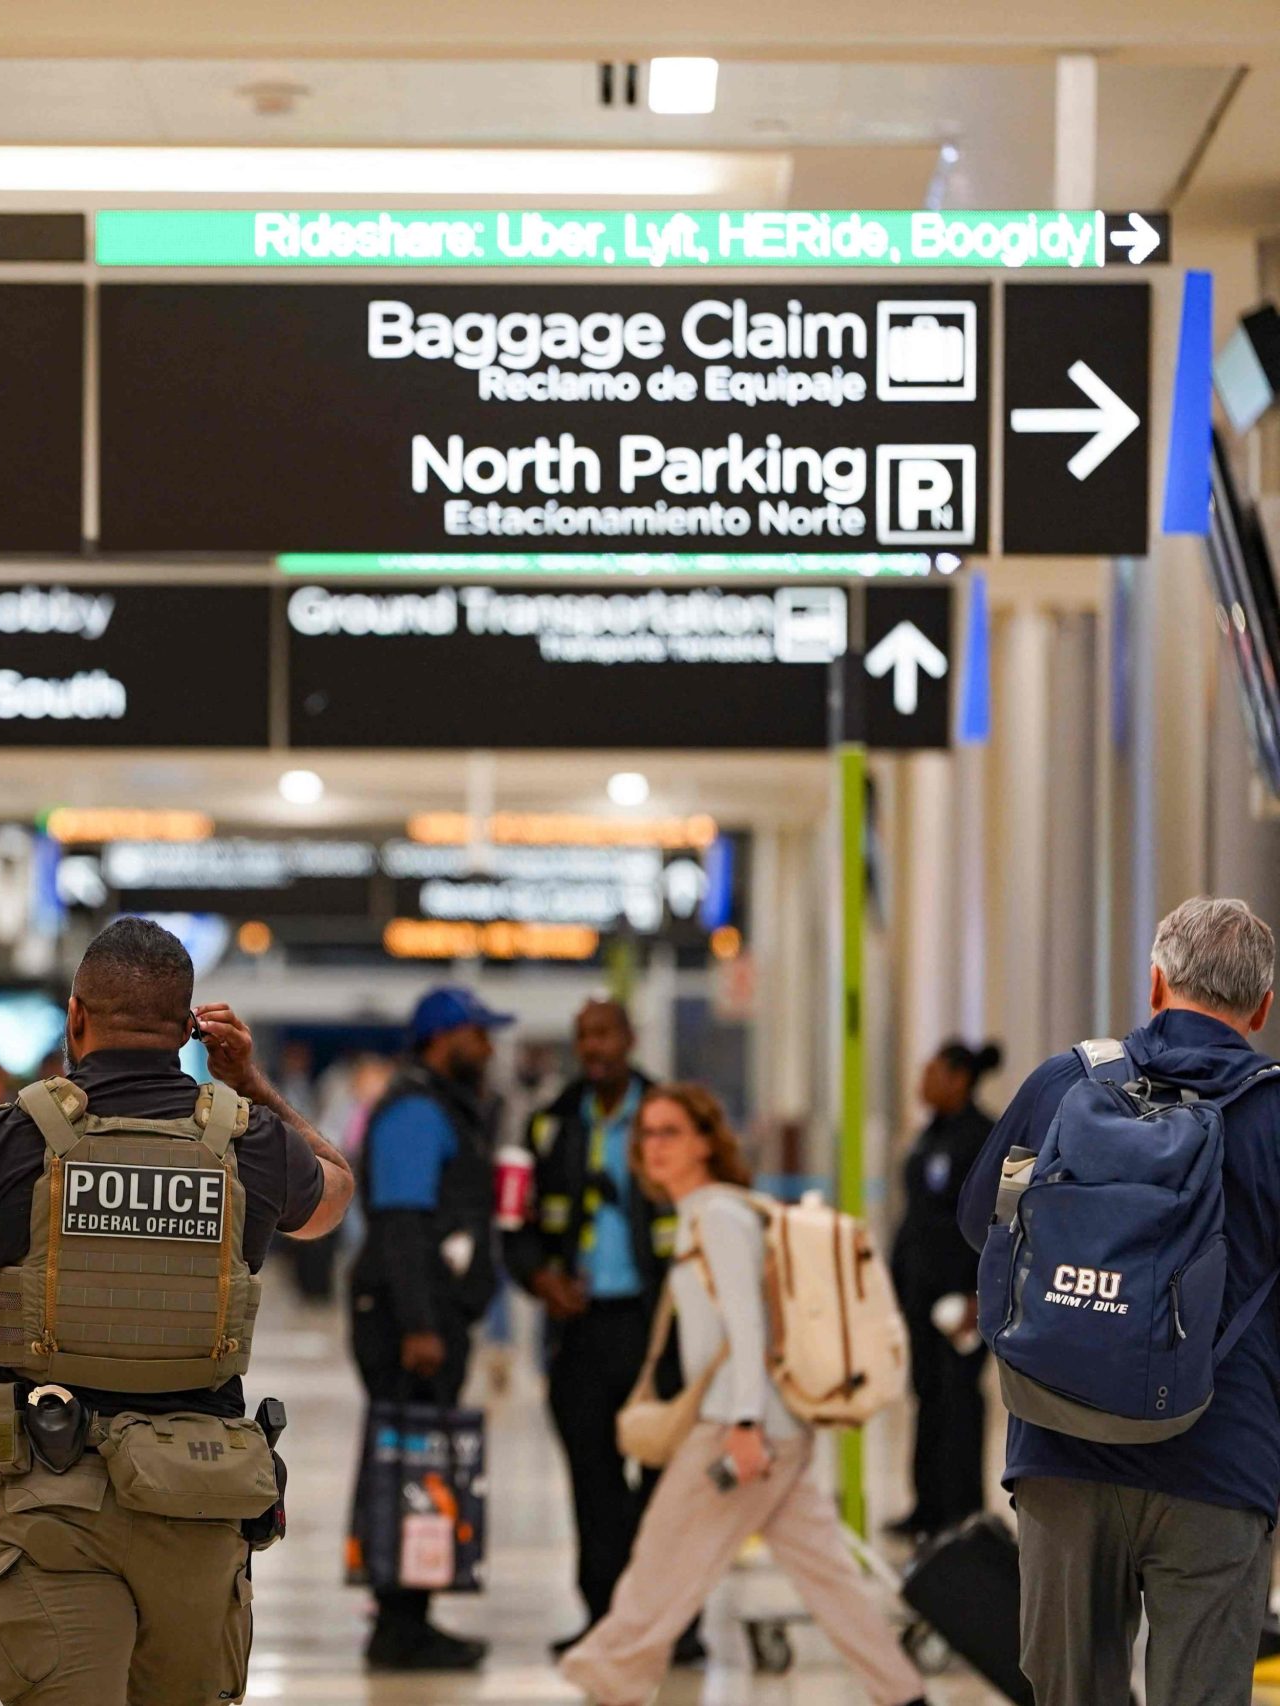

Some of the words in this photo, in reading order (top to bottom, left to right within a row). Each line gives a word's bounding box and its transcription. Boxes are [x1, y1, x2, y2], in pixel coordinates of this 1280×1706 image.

[255, 212, 484, 257] Rideshare:
[497, 212, 615, 263] Uber,
[625, 212, 709, 267] Lyft,
[719, 212, 900, 263] HERide,
[911, 213, 1093, 268] Boogidy
[368, 300, 666, 370] Baggage
[682, 299, 868, 359] Claim
[478, 364, 642, 402] Reclamo
[647, 364, 699, 402] de
[705, 364, 867, 408] Equipaje
[412, 433, 601, 495] North
[620, 433, 867, 505] Parking
[444, 499, 752, 537] Estacionamiento
[759, 499, 867, 537] Norte
[69, 1170, 220, 1214] POLICE
[67, 1213, 141, 1232] FEDERAL
[146, 1216, 217, 1236] OFFICER
[1053, 1264, 1122, 1299] CBU
[1044, 1291, 1081, 1307] SWIM
[1092, 1300, 1128, 1314] DIVE
[187, 1441, 225, 1462] HP
